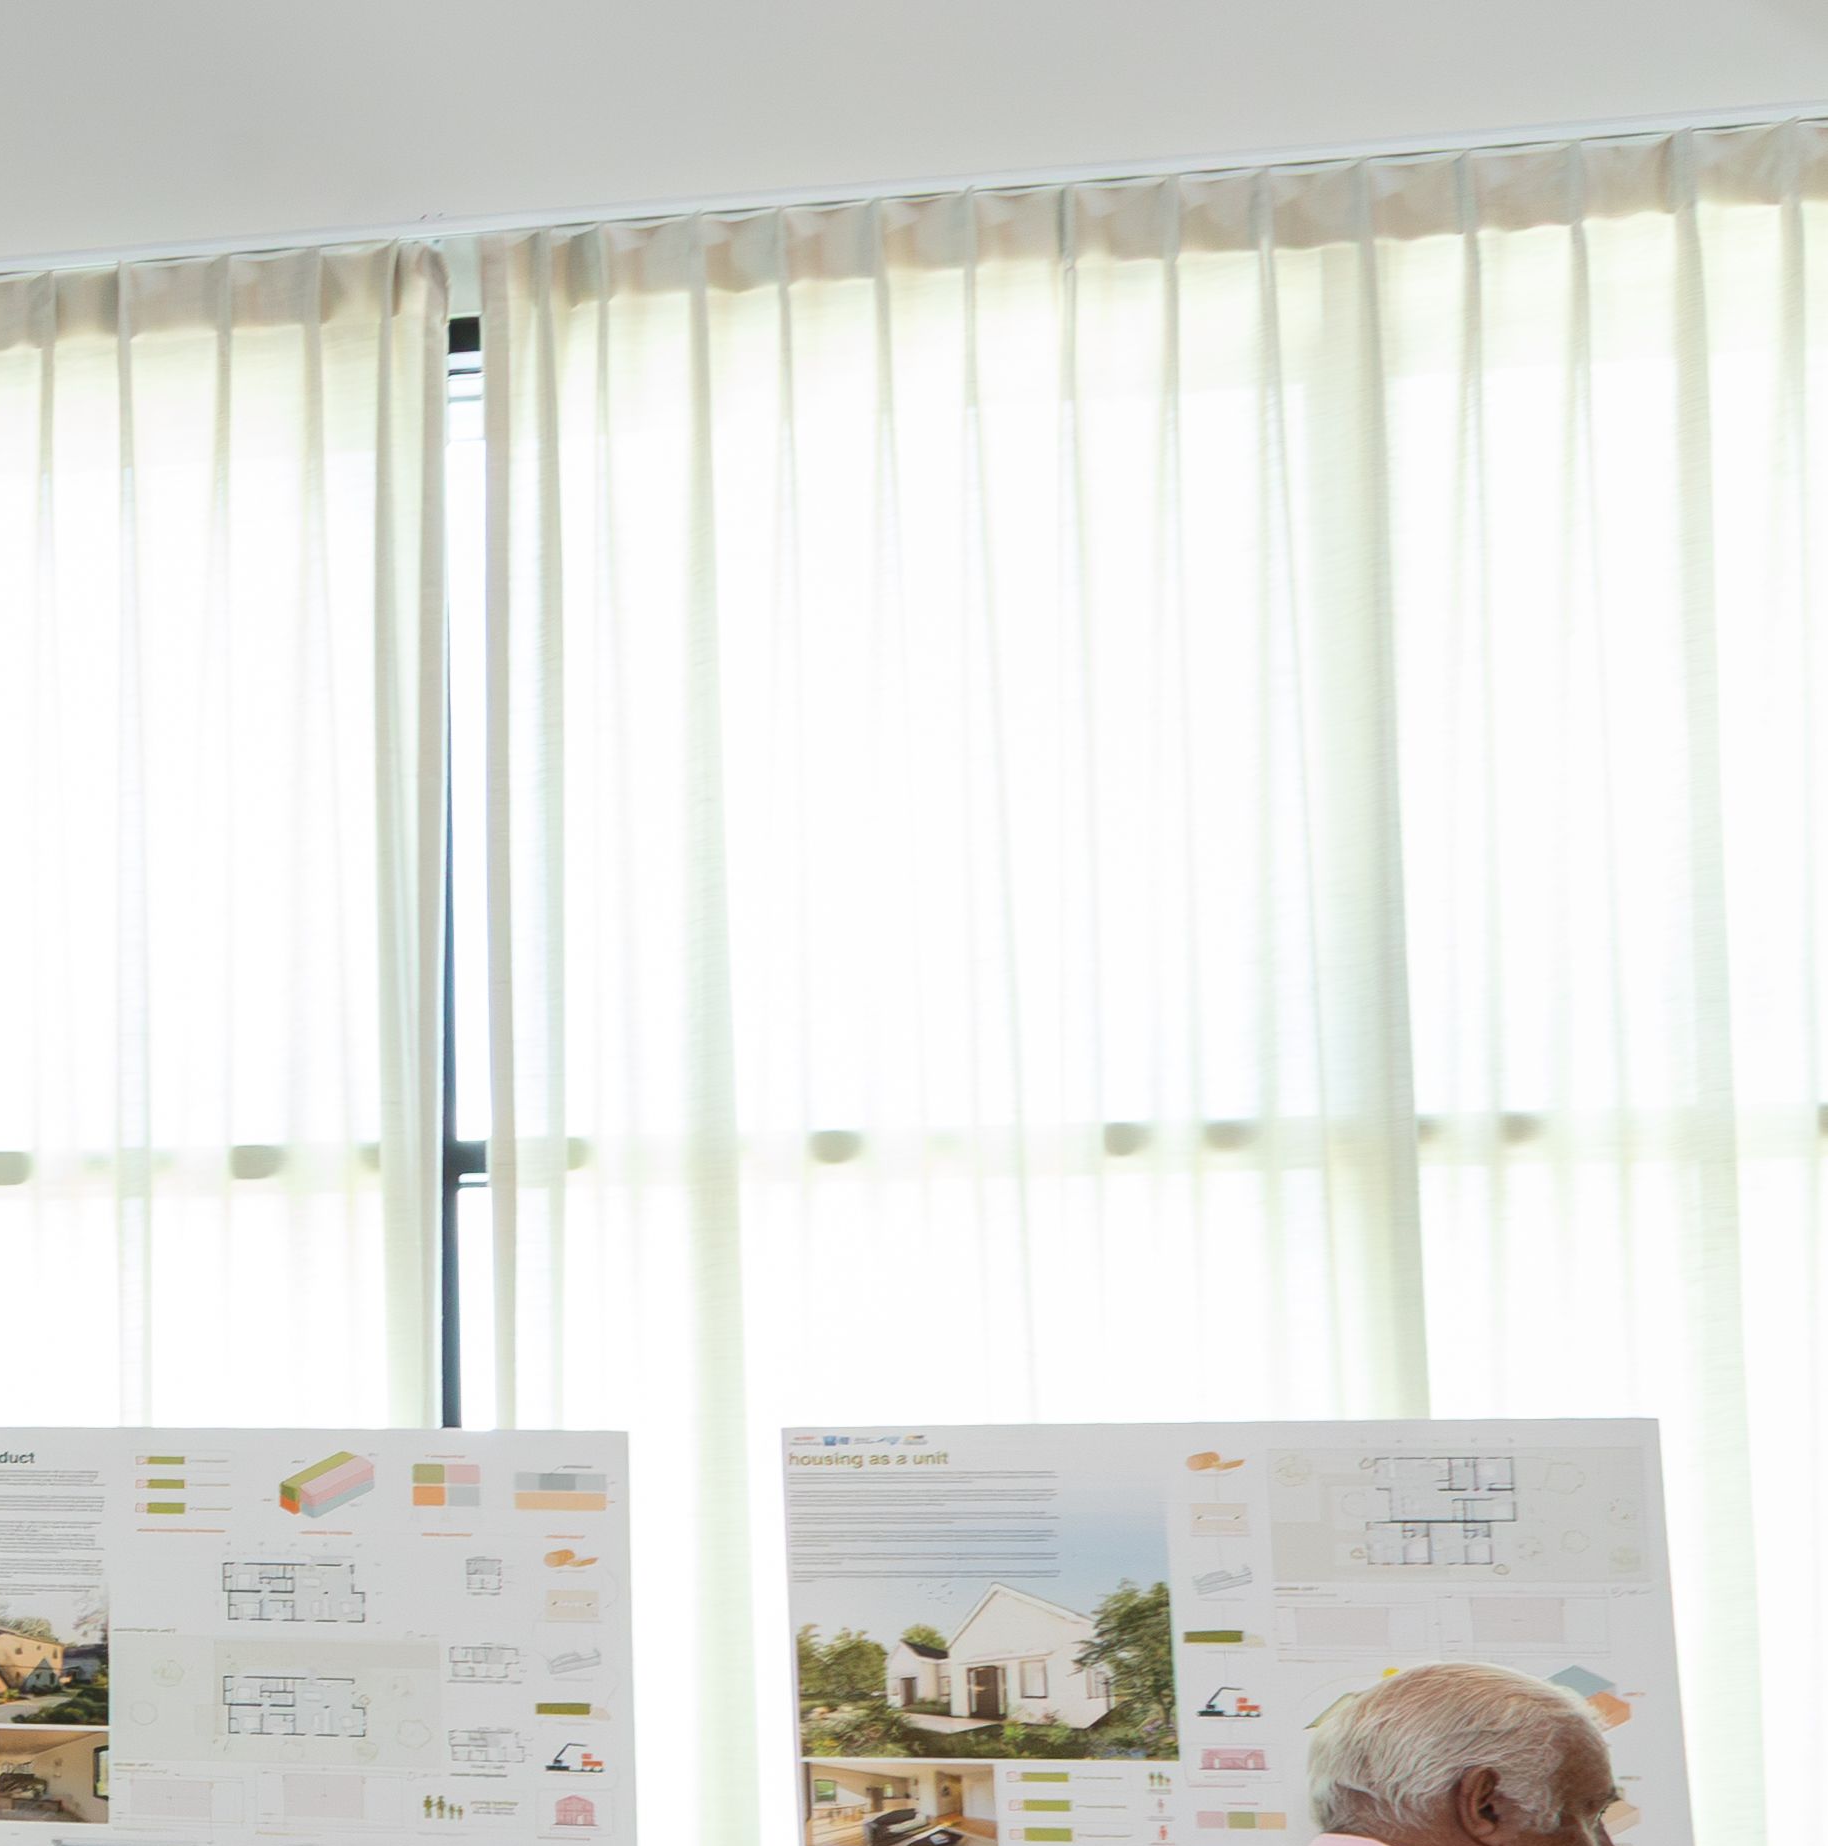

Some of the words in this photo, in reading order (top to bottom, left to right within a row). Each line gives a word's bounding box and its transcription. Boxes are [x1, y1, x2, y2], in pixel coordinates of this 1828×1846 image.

[788, 1452, 863, 1469] housing
[869, 1455, 890, 1466] as
[895, 1454, 908, 1465] a
[913, 1451, 949, 1466] unit
